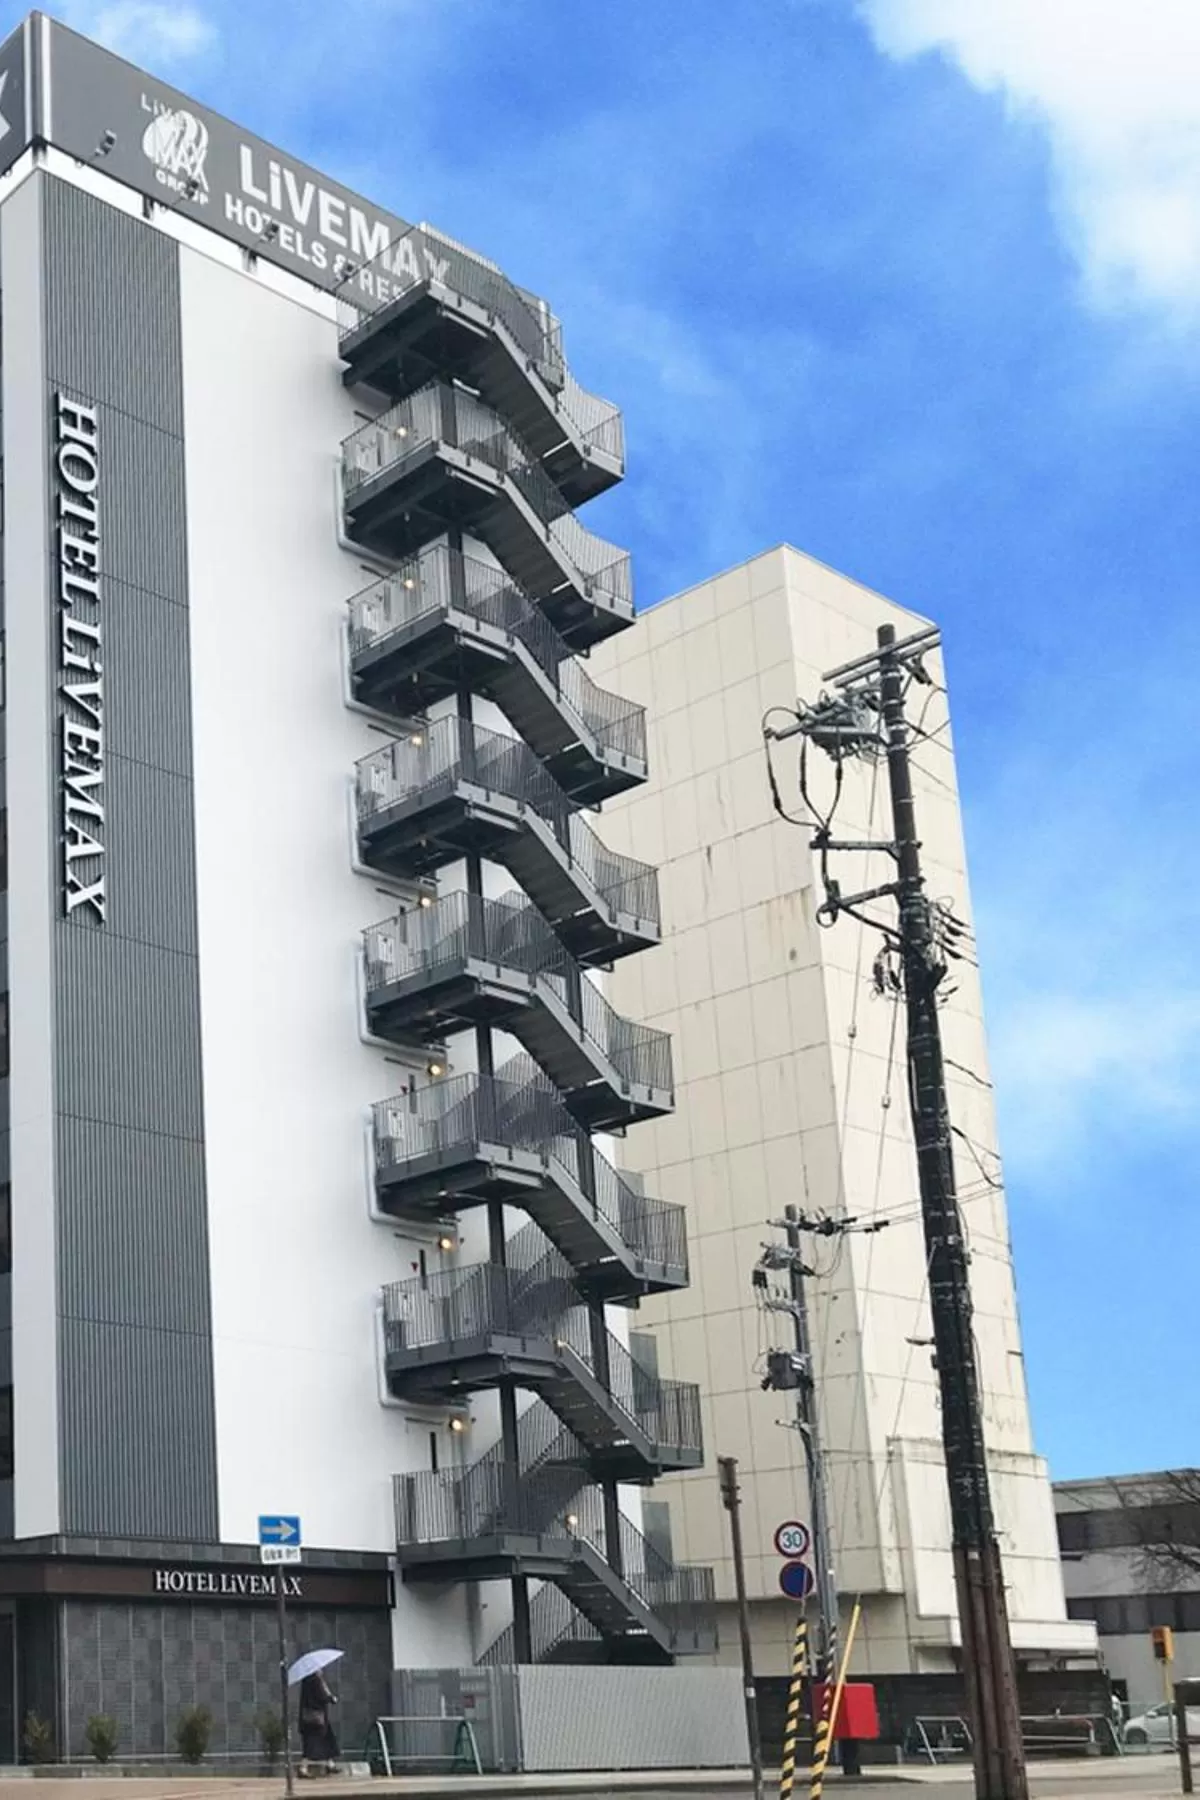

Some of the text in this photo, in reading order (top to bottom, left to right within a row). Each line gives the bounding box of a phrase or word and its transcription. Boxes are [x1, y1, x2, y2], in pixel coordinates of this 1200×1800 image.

[58, 391, 100, 604] HOTEL
[782, 1530, 803, 1549] 30
[155, 1569, 218, 1592] HOTEL
